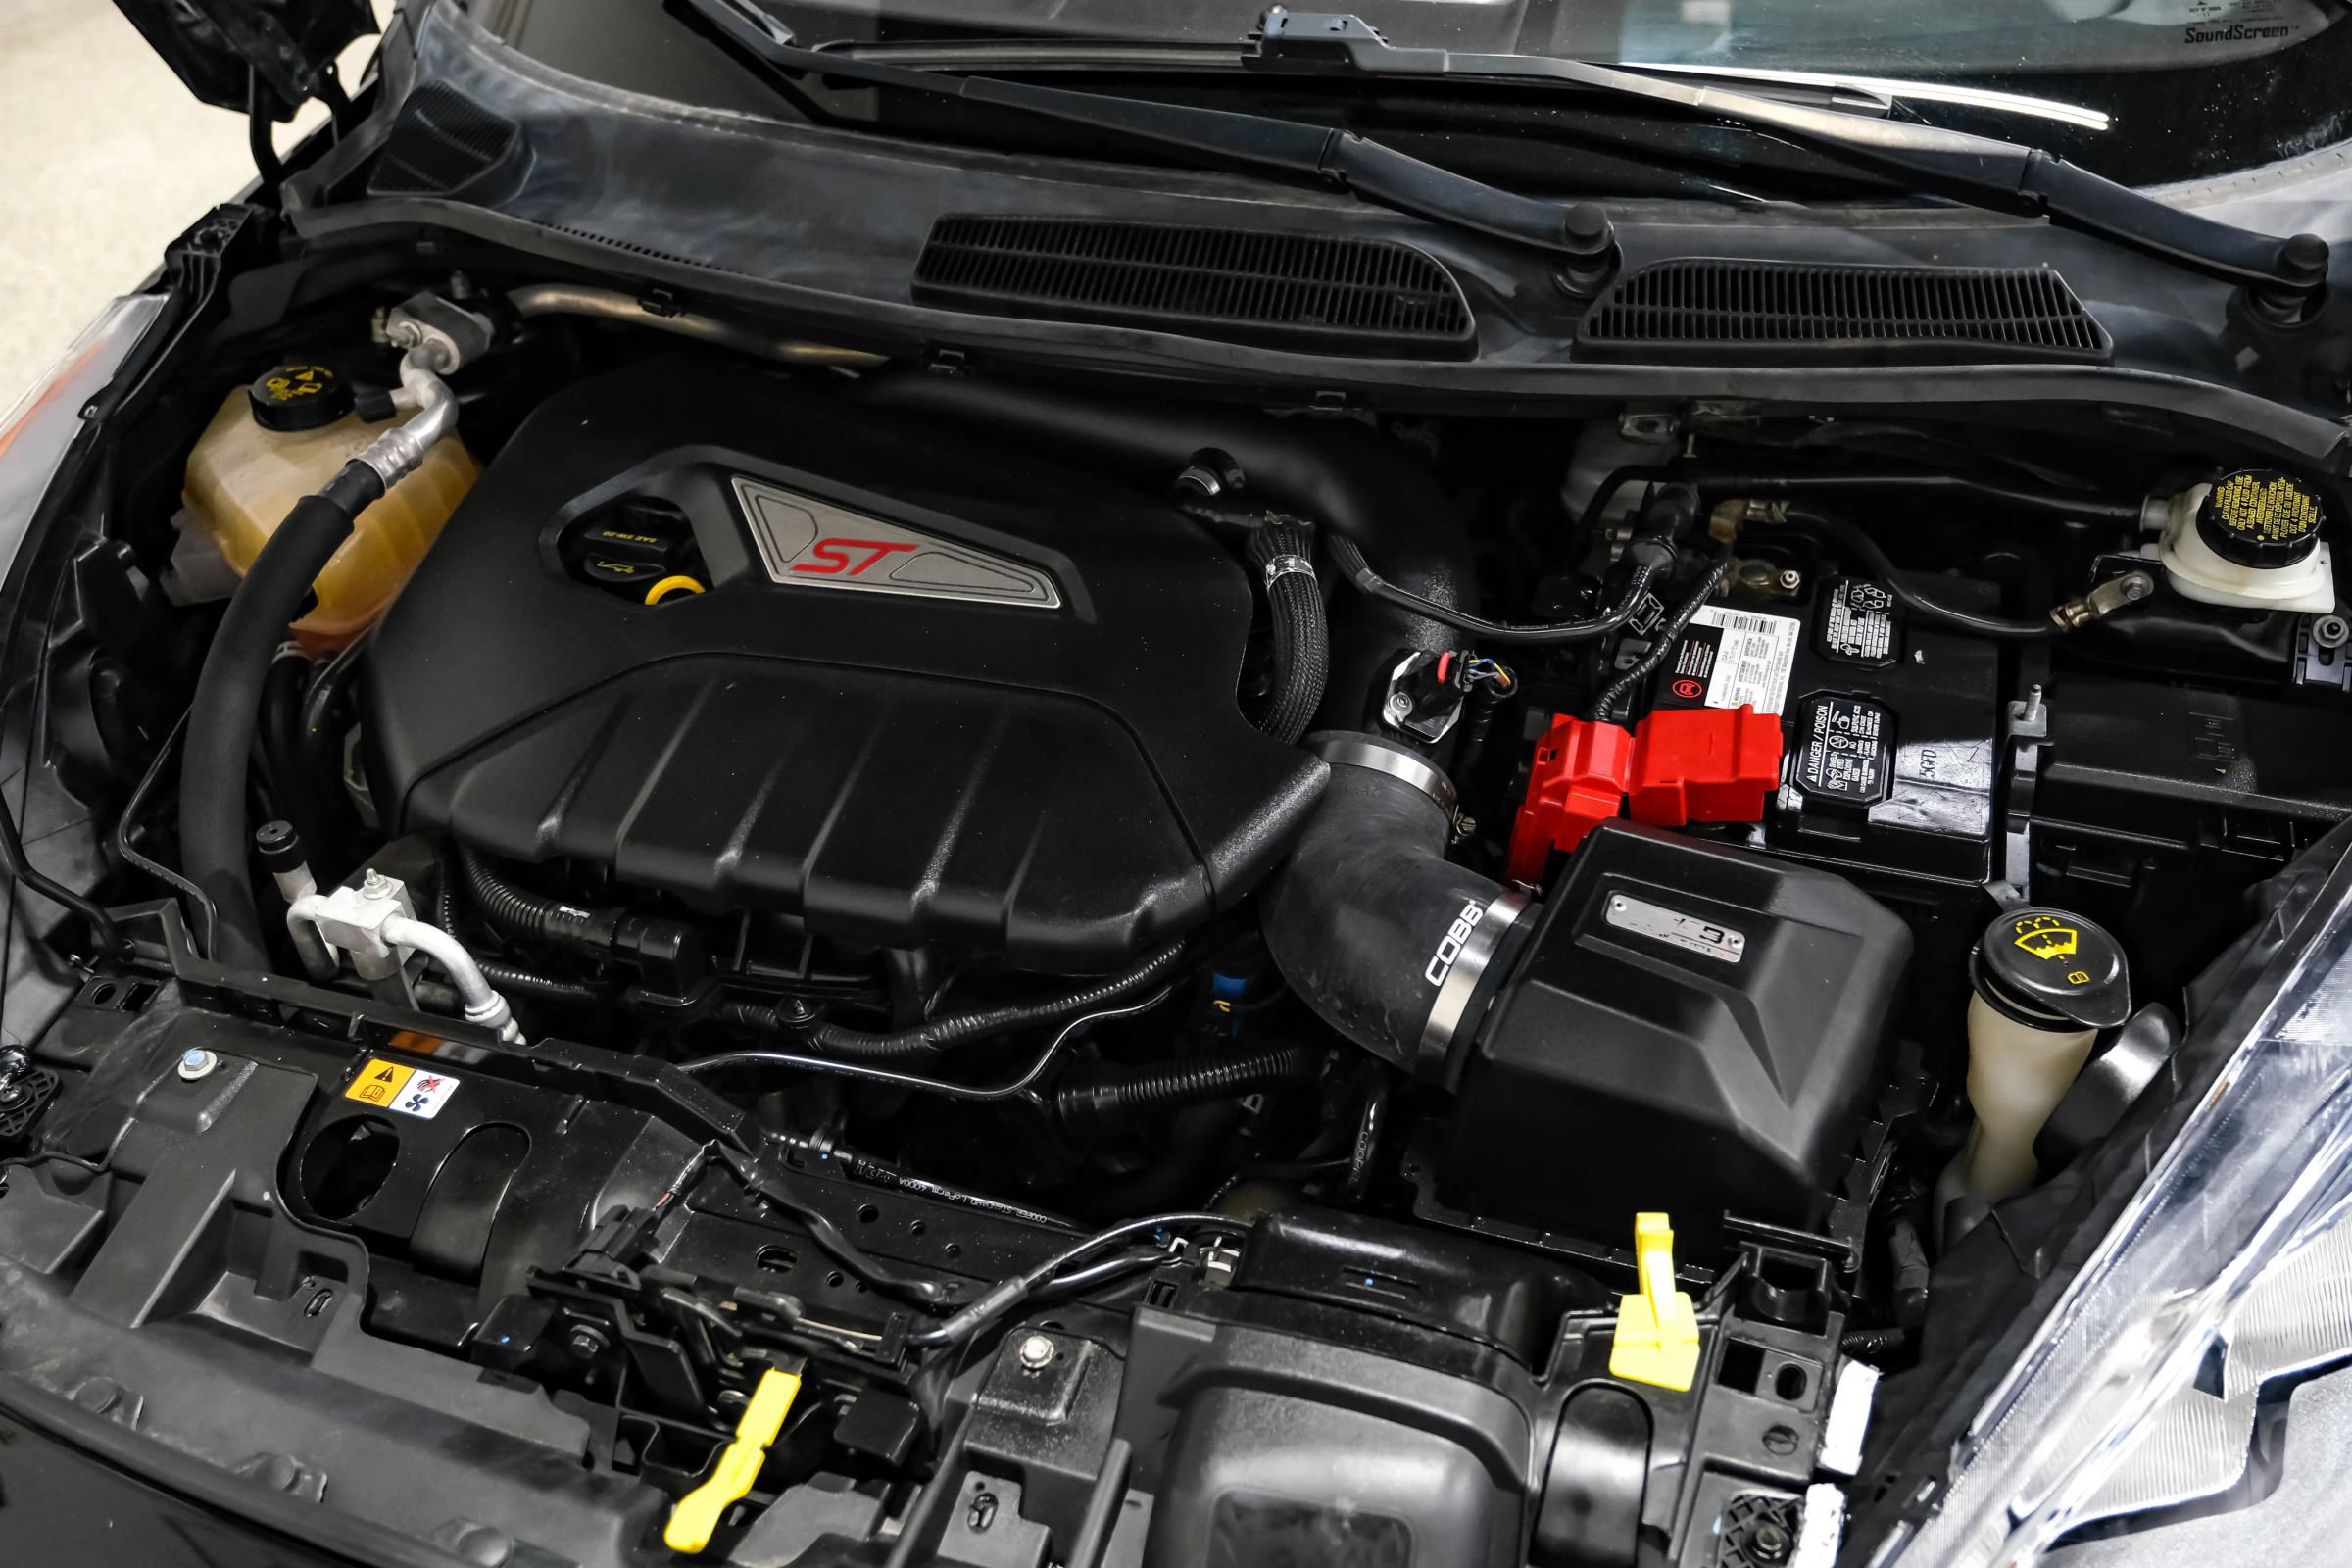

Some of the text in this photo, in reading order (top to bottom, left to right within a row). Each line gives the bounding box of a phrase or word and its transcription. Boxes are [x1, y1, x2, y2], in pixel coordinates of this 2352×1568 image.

[2247, 508, 2256, 525] SEALED
[790, 537, 920, 576] ST
[1814, 706, 1828, 734] POISON
[1808, 741, 1822, 774] DANGER
[1425, 900, 1483, 987] COBB
